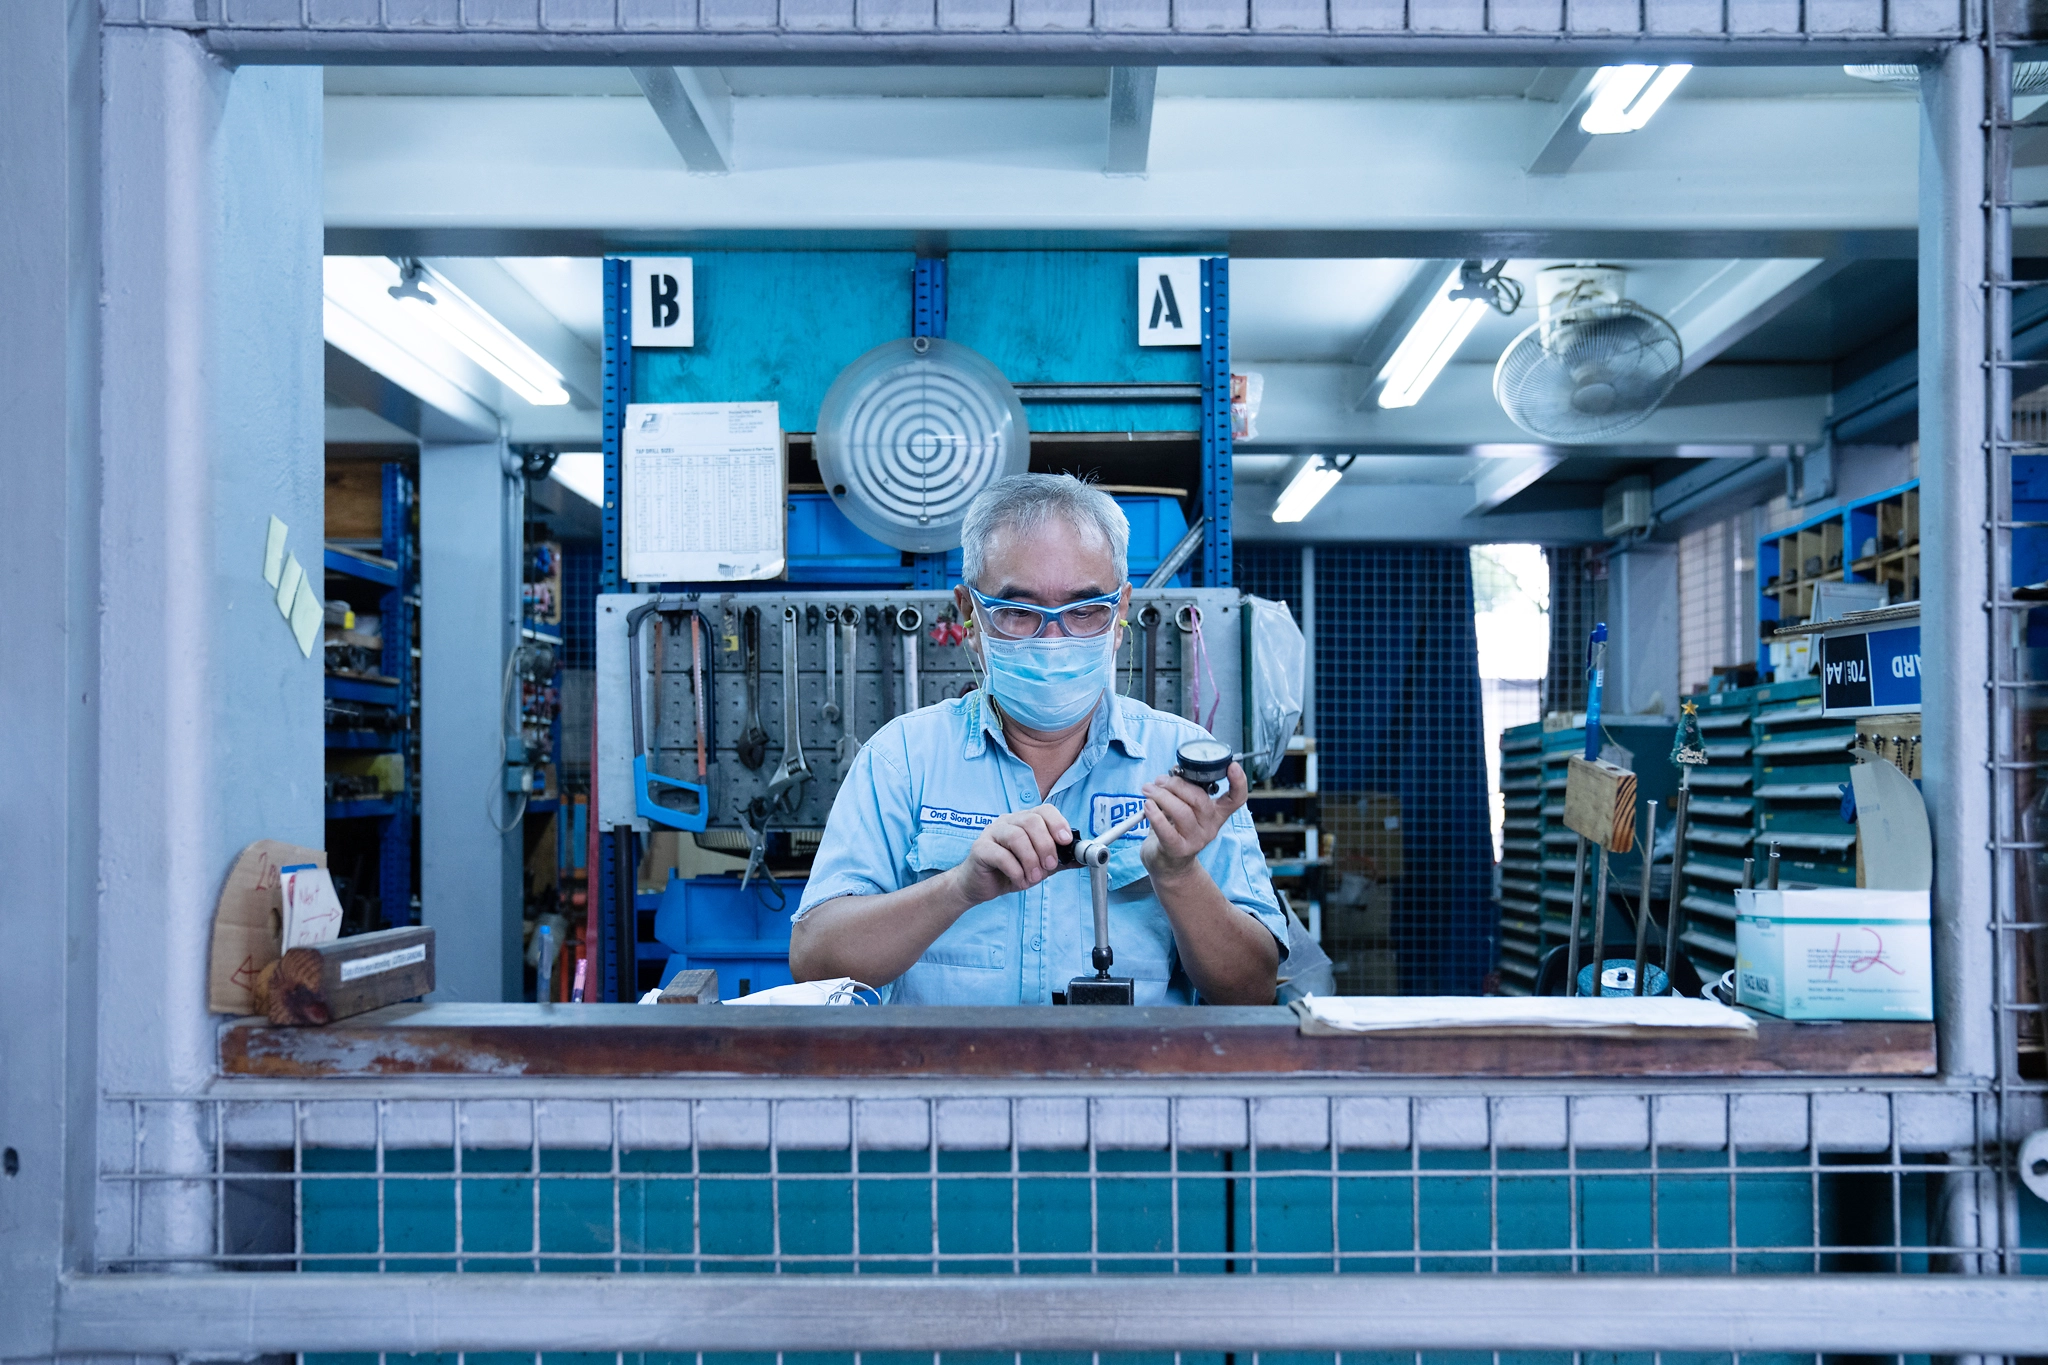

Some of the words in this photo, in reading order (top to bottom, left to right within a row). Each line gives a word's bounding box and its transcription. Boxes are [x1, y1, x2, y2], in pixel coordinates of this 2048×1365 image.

[650, 274, 680, 329] B
[1148, 274, 1183, 330] A
[1826, 661, 1843, 685] A4
[1851, 659, 1867, 683] 70
[930, 810, 947, 820] Ong
[1828, 927, 1906, 981] 12
